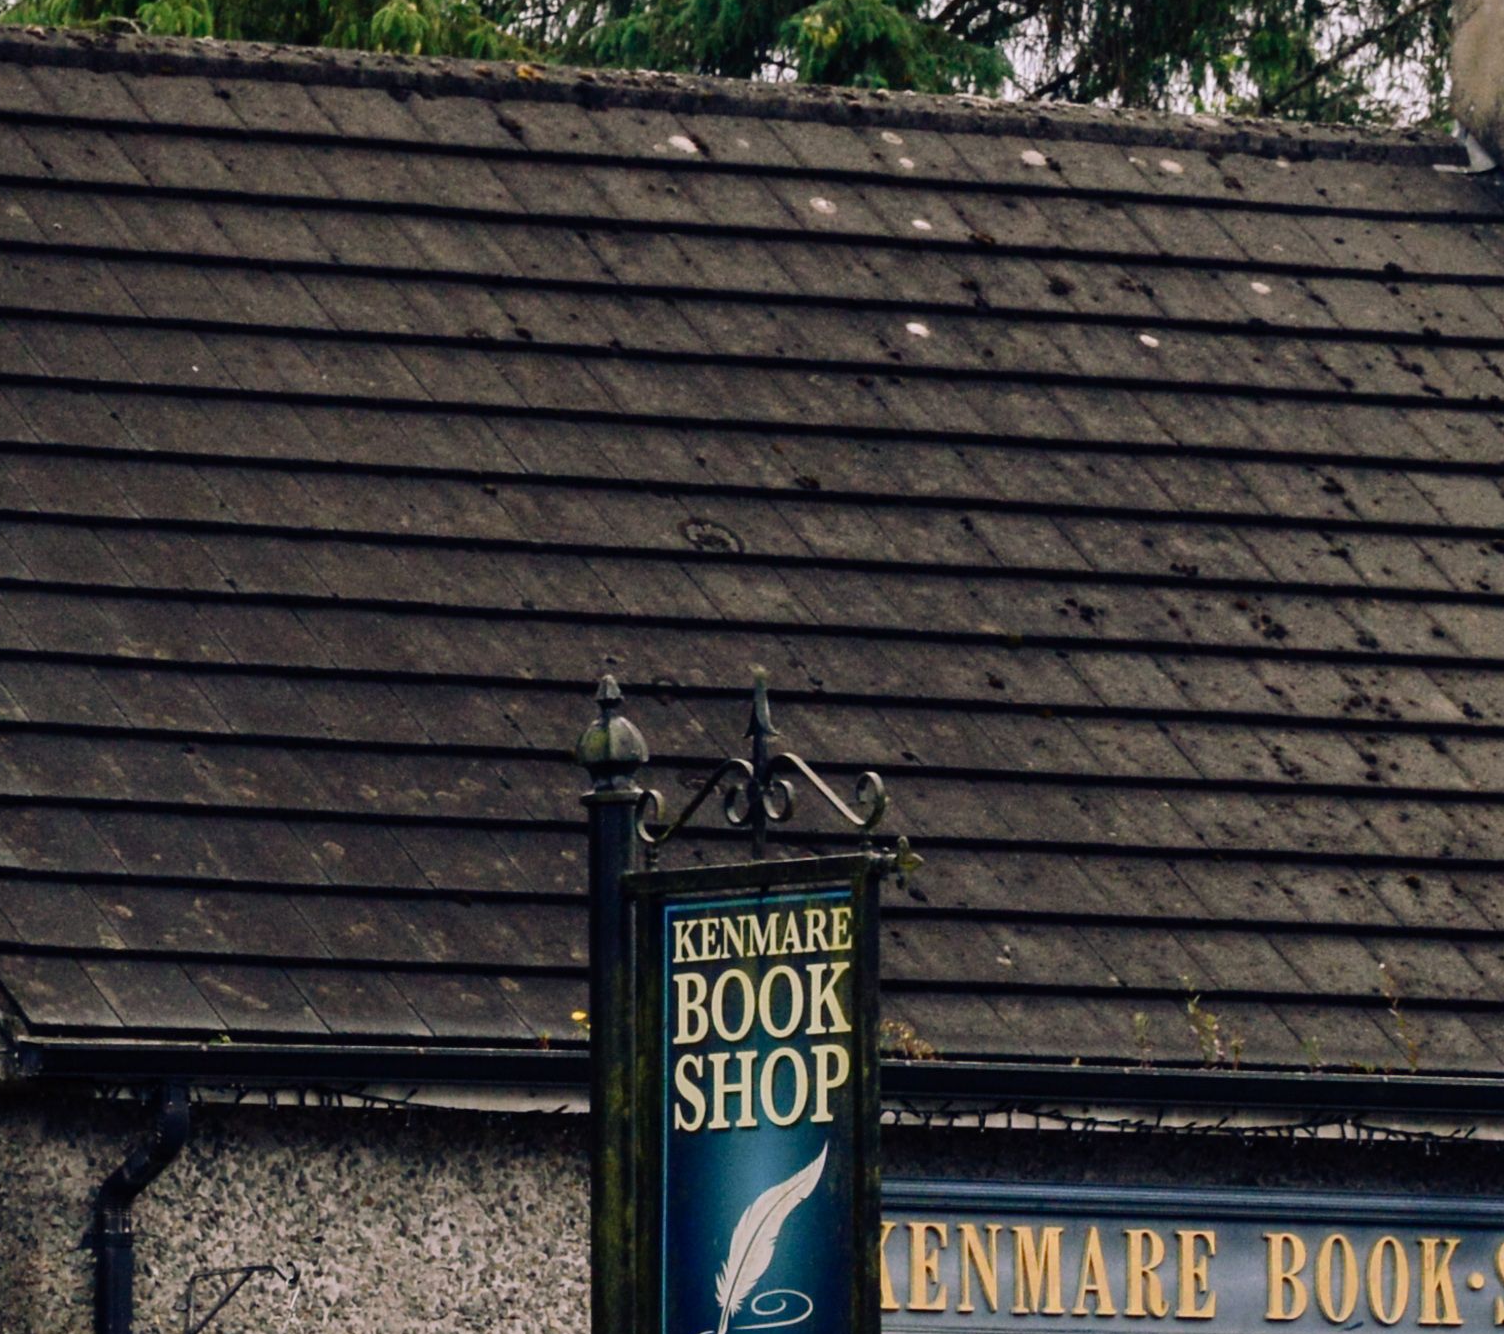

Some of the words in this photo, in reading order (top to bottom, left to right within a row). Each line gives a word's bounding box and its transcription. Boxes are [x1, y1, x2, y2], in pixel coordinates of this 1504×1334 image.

[672, 906, 853, 964] KENMARE
[673, 961, 852, 1046] BOOK
[674, 1043, 851, 1132] SHOP
